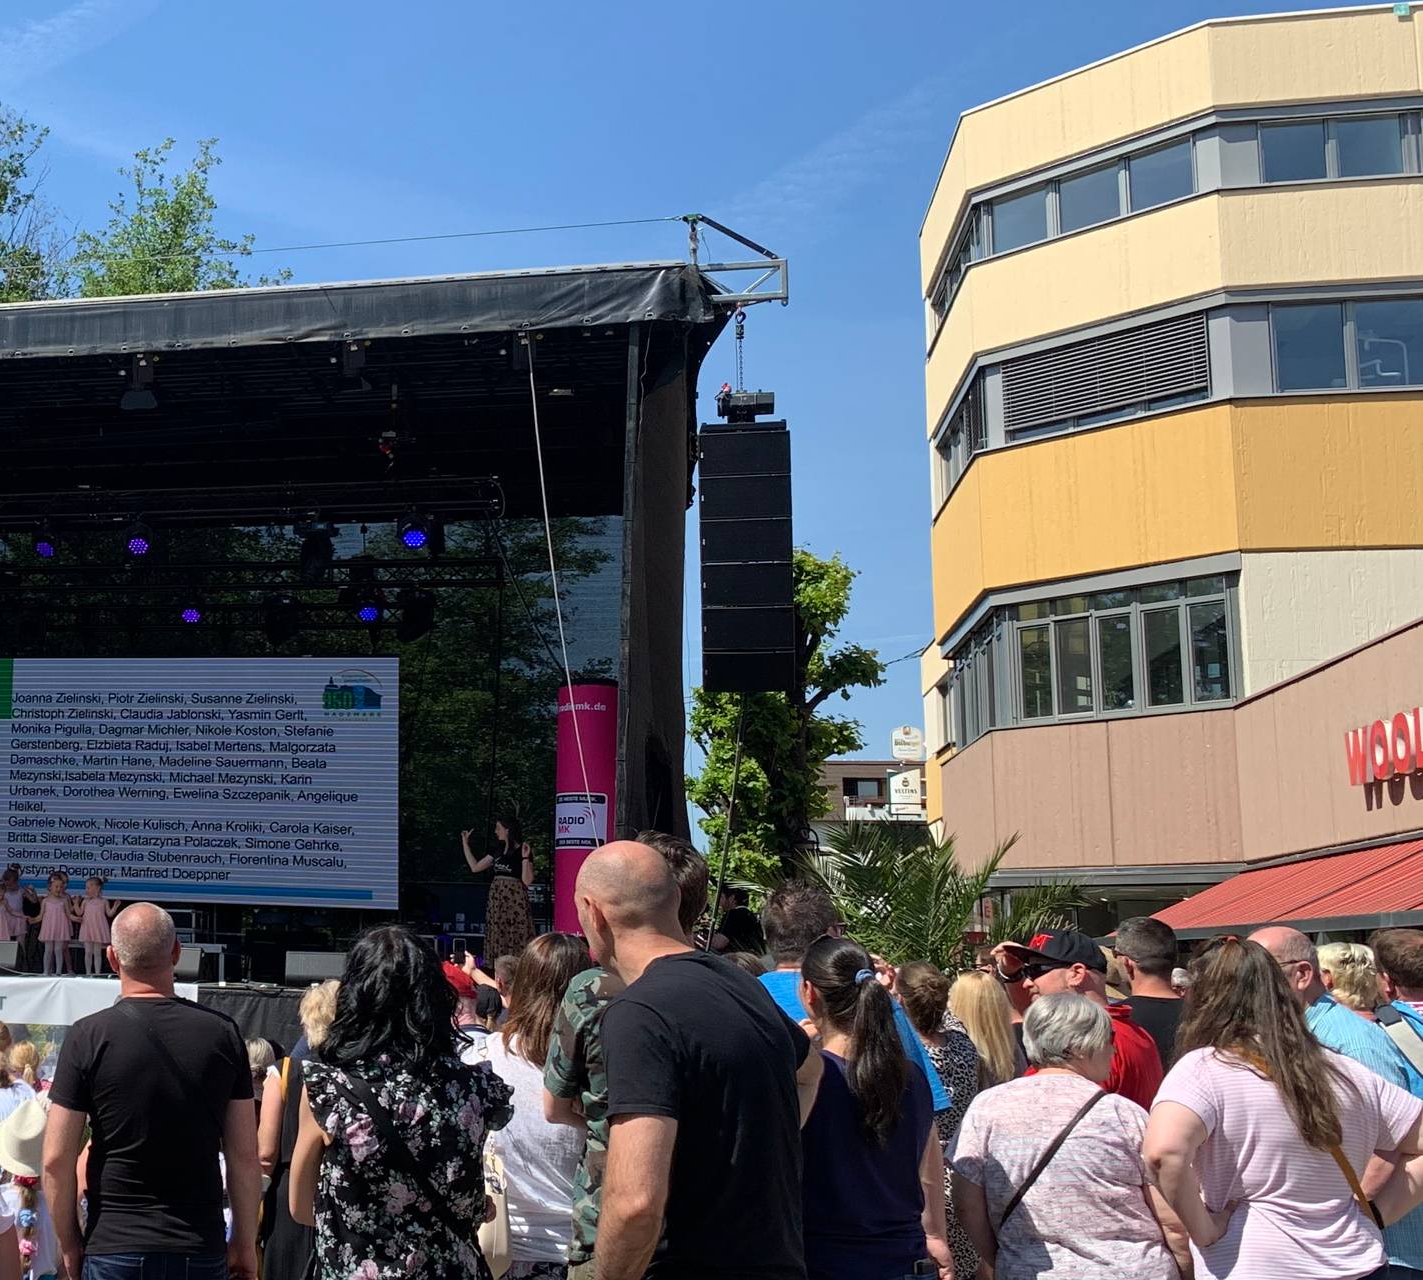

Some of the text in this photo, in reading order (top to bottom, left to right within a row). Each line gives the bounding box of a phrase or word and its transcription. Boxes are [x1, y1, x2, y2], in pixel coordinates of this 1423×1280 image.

[12, 693, 297, 706] Joanna Zielinski, Piotr Zielinski, Susanne Zielinski,
[11, 708, 64, 721] Christoph
[67, 709, 116, 720] Zielinski,
[120, 709, 163, 719] Claudia
[167, 709, 224, 721] Jablonski,
[228, 709, 271, 720] Yasmin
[11, 723, 51, 734] Monika
[54, 723, 95, 736] Pigulla,
[99, 724, 144, 737] Dagmar
[147, 724, 191, 736] Michler,
[196, 724, 231, 736] Nikole
[284, 725, 334, 737] Stefanie
[10, 739, 335, 754] Gerstenberg, Elzbieta Raduj, Isabel Mertens, Malgorzata
[10, 754, 327, 770] Damaschke, Martin Hane, Madeline Sauermann, Beata
[108, 771, 165, 784] Mezynski,
[169, 772, 214, 784] Michael
[218, 773, 277, 787] Mezynski,
[281, 773, 312, 785] Karin
[9, 786, 359, 803] Urbanek, Dorothea Werning, Ewelina Szczepanik, Angelique
[8, 801, 46, 813] Heikel,
[8, 816, 55, 828] Gabriele
[104, 818, 140, 829] Nicole
[143, 818, 188, 832] Kulisch,
[191, 820, 222, 832] Anna
[269, 822, 309, 834] Carola
[313, 823, 355, 836] Kaiser,
[7, 832, 343, 852] Britta Siewer-Engel, Katarzyna Polaczek, Simone Gehrke,
[7, 847, 50, 859] Sabrina
[100, 850, 144, 862] Claudia
[147, 852, 225, 865] Stubenrauch,
[229, 853, 289, 866] Florentina
[292, 855, 347, 869] Muscalu,
[121, 866, 168, 878] Manfred
[172, 868, 231, 882] Doeppner
